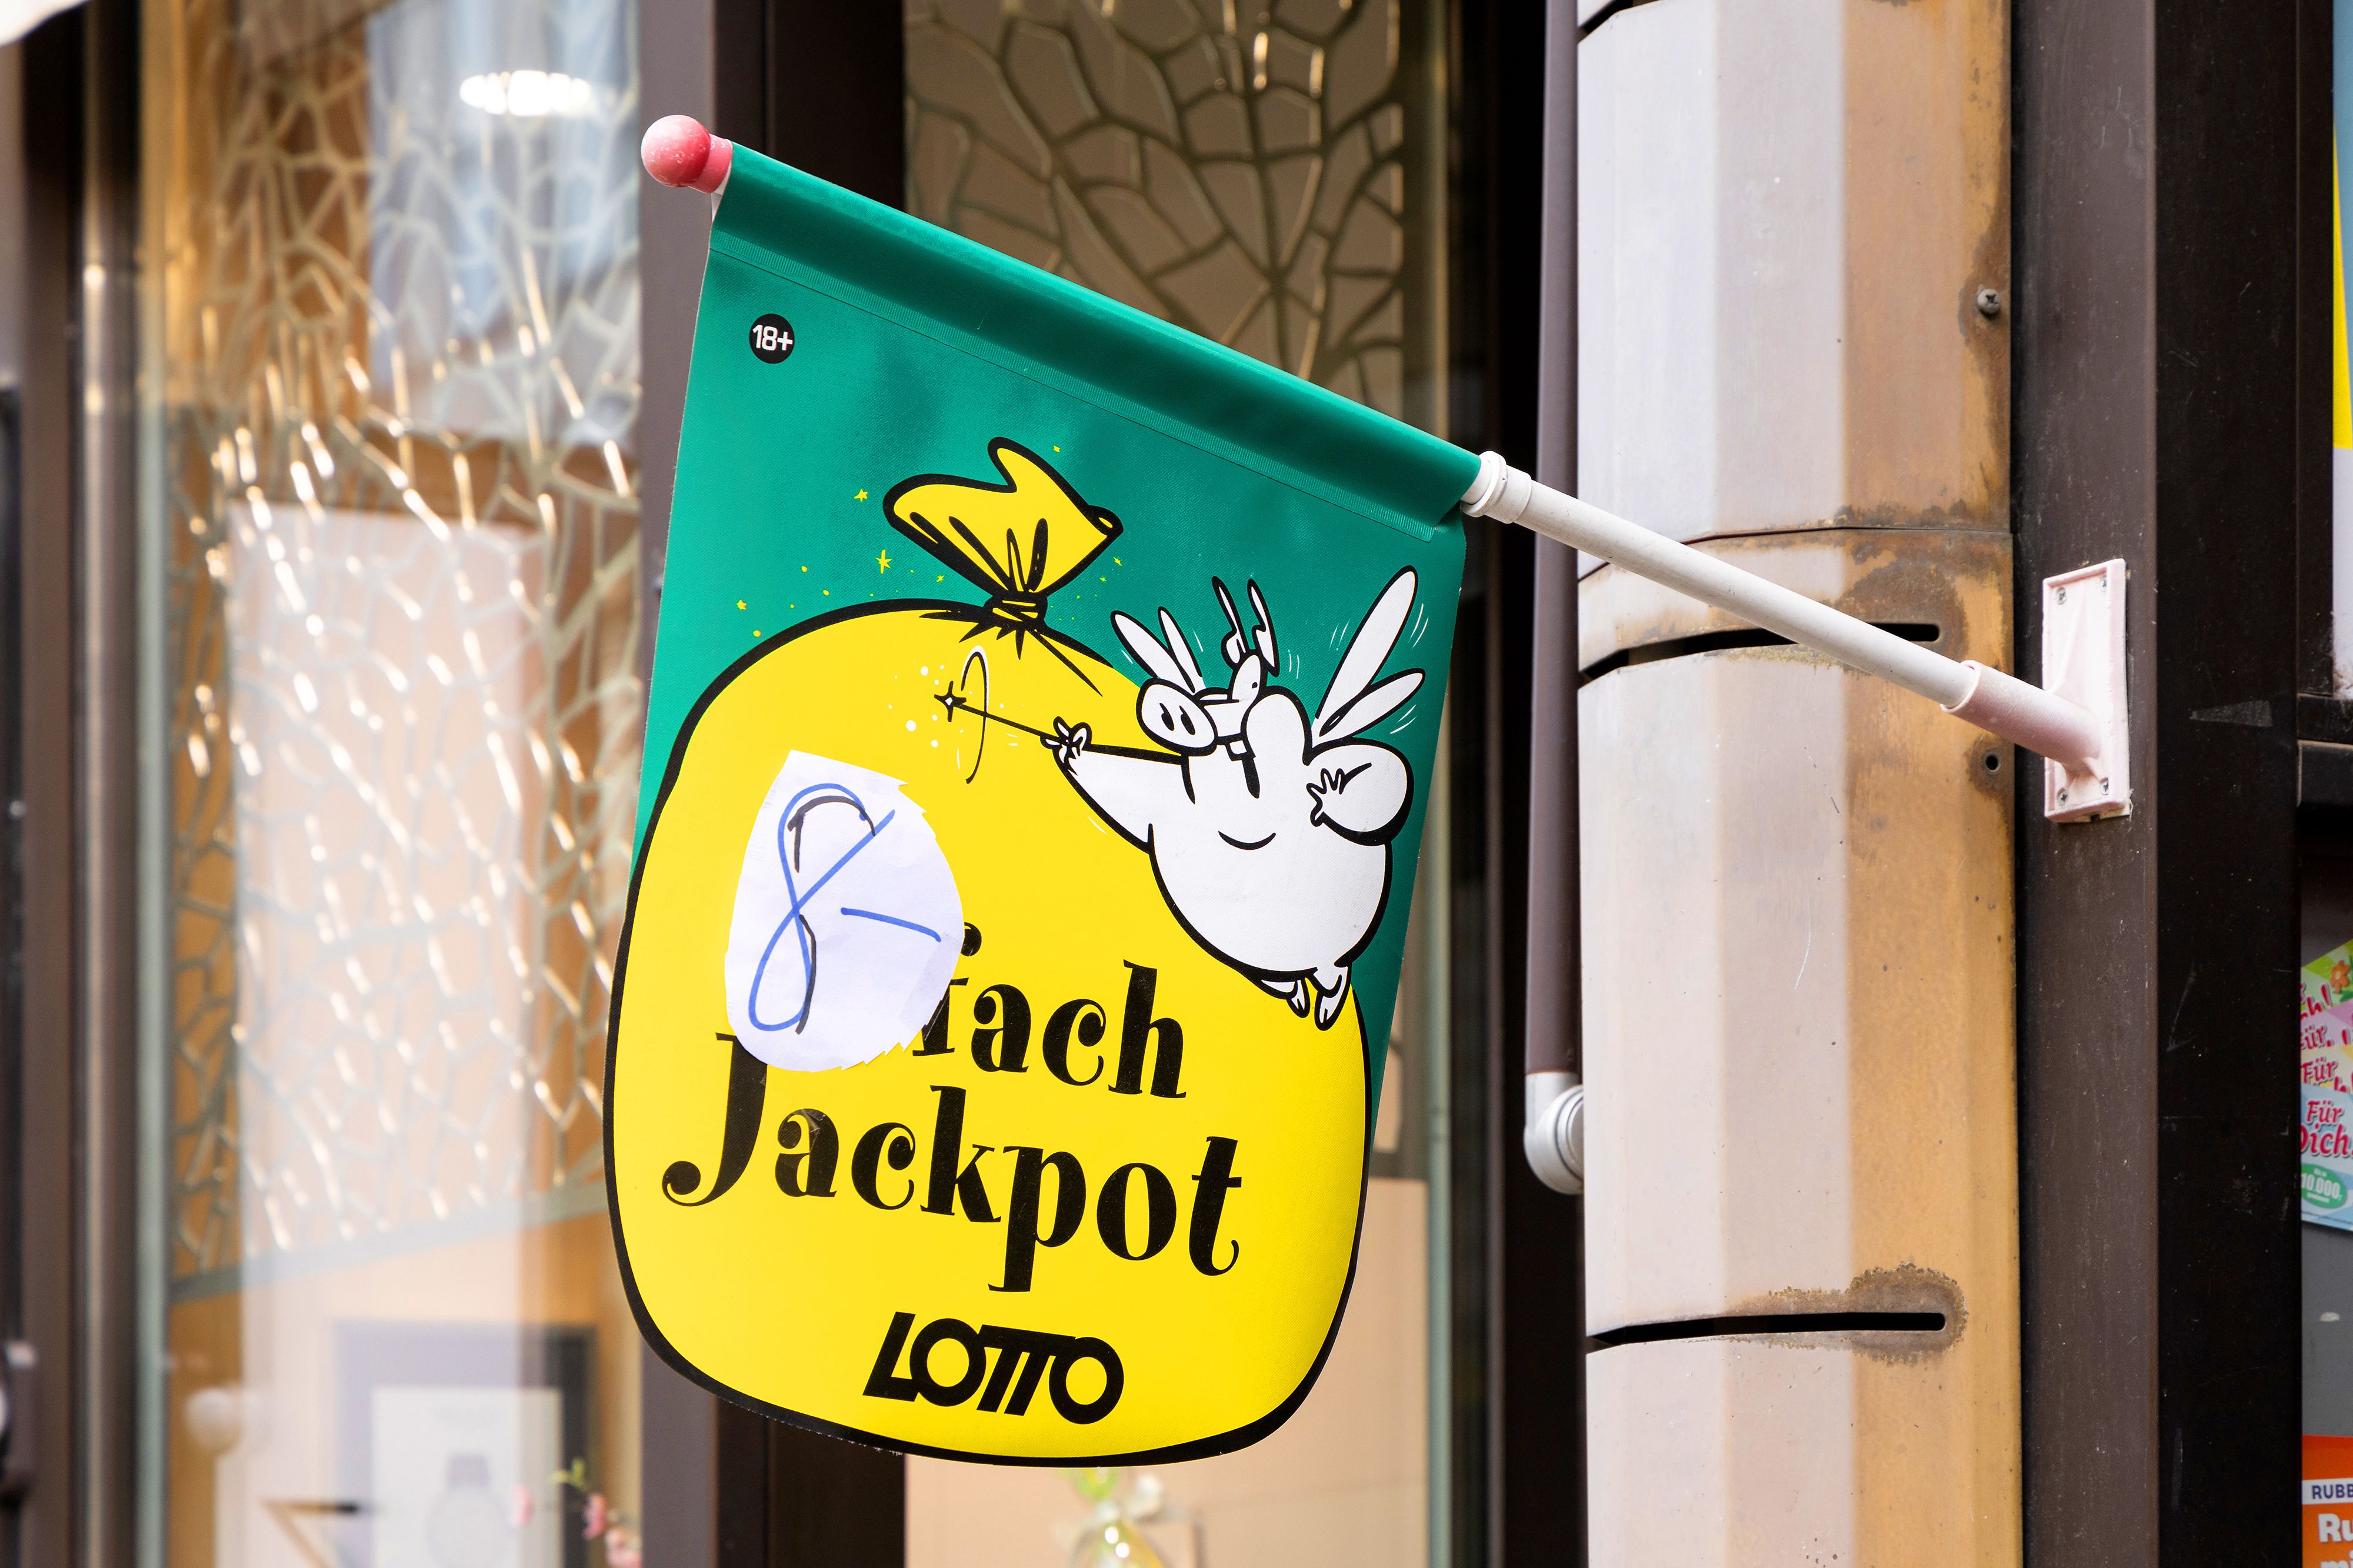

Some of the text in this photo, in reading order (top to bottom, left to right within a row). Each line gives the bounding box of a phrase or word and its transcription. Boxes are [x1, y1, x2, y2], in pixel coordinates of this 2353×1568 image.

[752, 324, 793, 351] 18+
[2301, 1057, 2336, 1085] Für
[2307, 1099, 2343, 1124] Für
[661, 1032, 1242, 1293] Jackpot
[862, 1311, 1125, 1425] LOTTO
